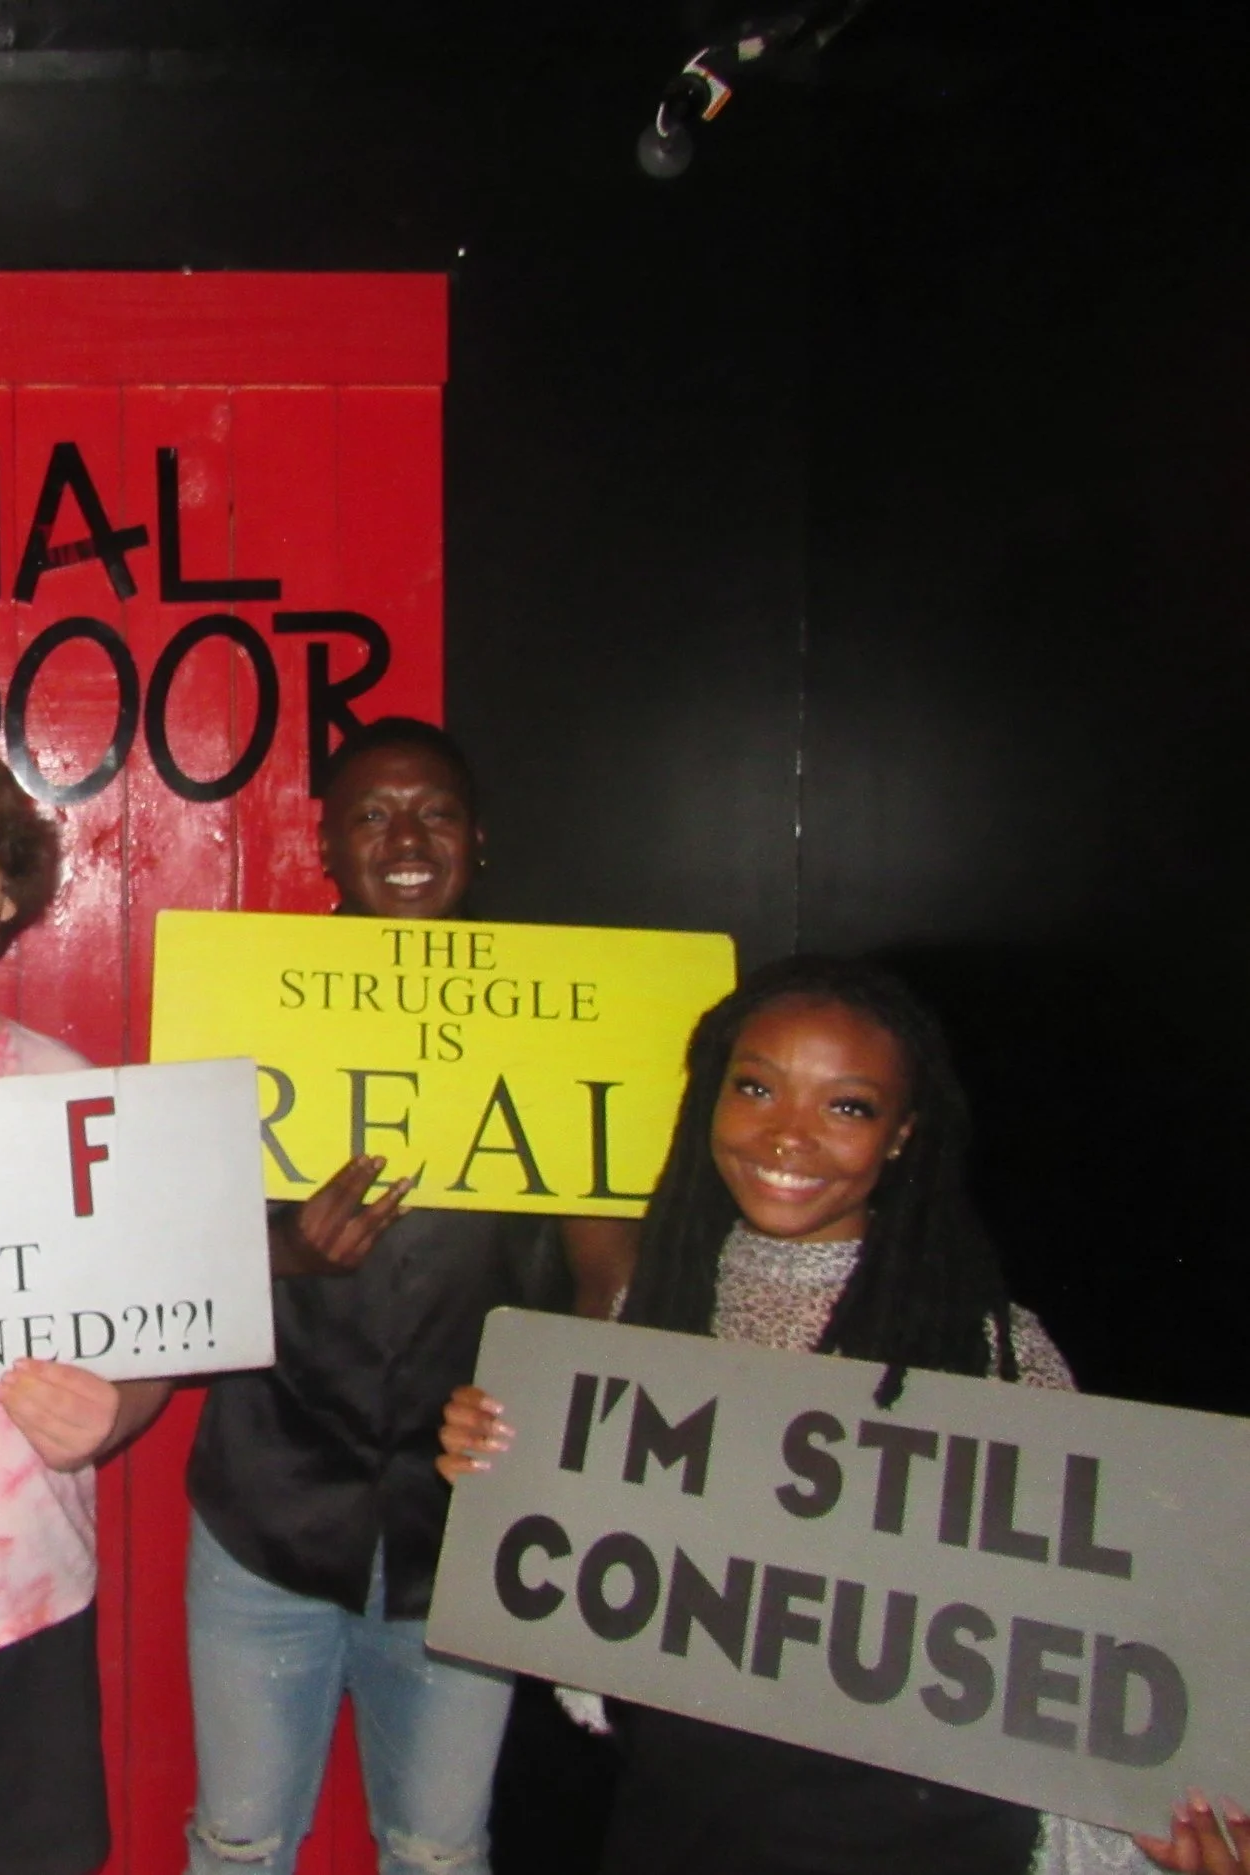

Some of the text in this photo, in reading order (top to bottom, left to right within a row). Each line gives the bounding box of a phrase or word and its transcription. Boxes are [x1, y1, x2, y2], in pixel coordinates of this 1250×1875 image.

[278, 969, 600, 1023] STRUGGLE
[382, 929, 497, 971] THE
[417, 1022, 465, 1063] IS
[256, 1065, 654, 1200] REAL
[559, 1372, 1133, 1580] I'M STILL
[493, 1513, 1189, 1768] CONFUSED
